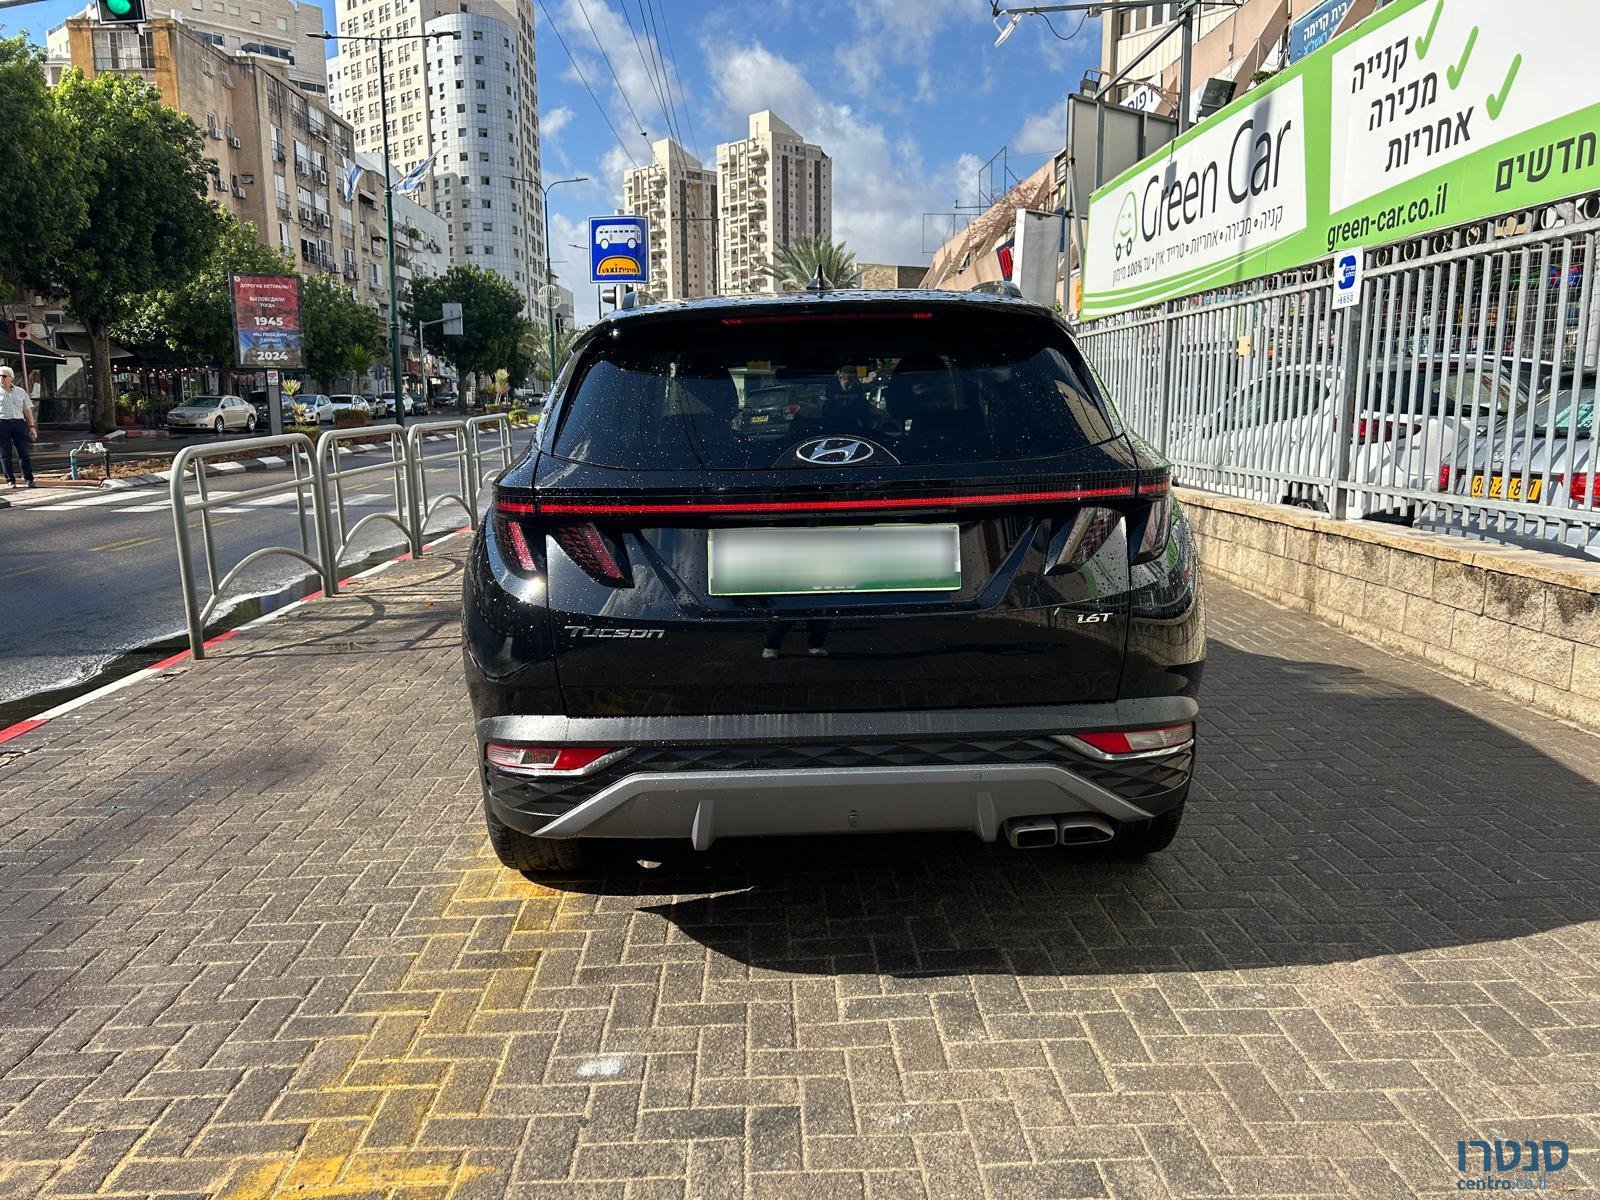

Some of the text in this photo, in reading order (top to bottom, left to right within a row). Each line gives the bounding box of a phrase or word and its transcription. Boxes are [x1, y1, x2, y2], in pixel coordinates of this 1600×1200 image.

[1303, 12, 1329, 41] קדימה
[1331, 2, 1347, 22] בית
[1351, 36, 1409, 94] קנייה
[1368, 72, 1438, 132] מכירה
[1385, 106, 1475, 172] אחריות
[1495, 132, 1597, 193] חדשים
[1141, 119, 1292, 243] Green Car
[1225, 217, 1252, 243] מכירה
[1259, 205, 1283, 232] קניה
[1327, 183, 1448, 252] green-car.co.il
[1190, 229, 1218, 255] אחריות
[254, 316, 284, 326] 1945
[256, 351, 289, 361] 2024
